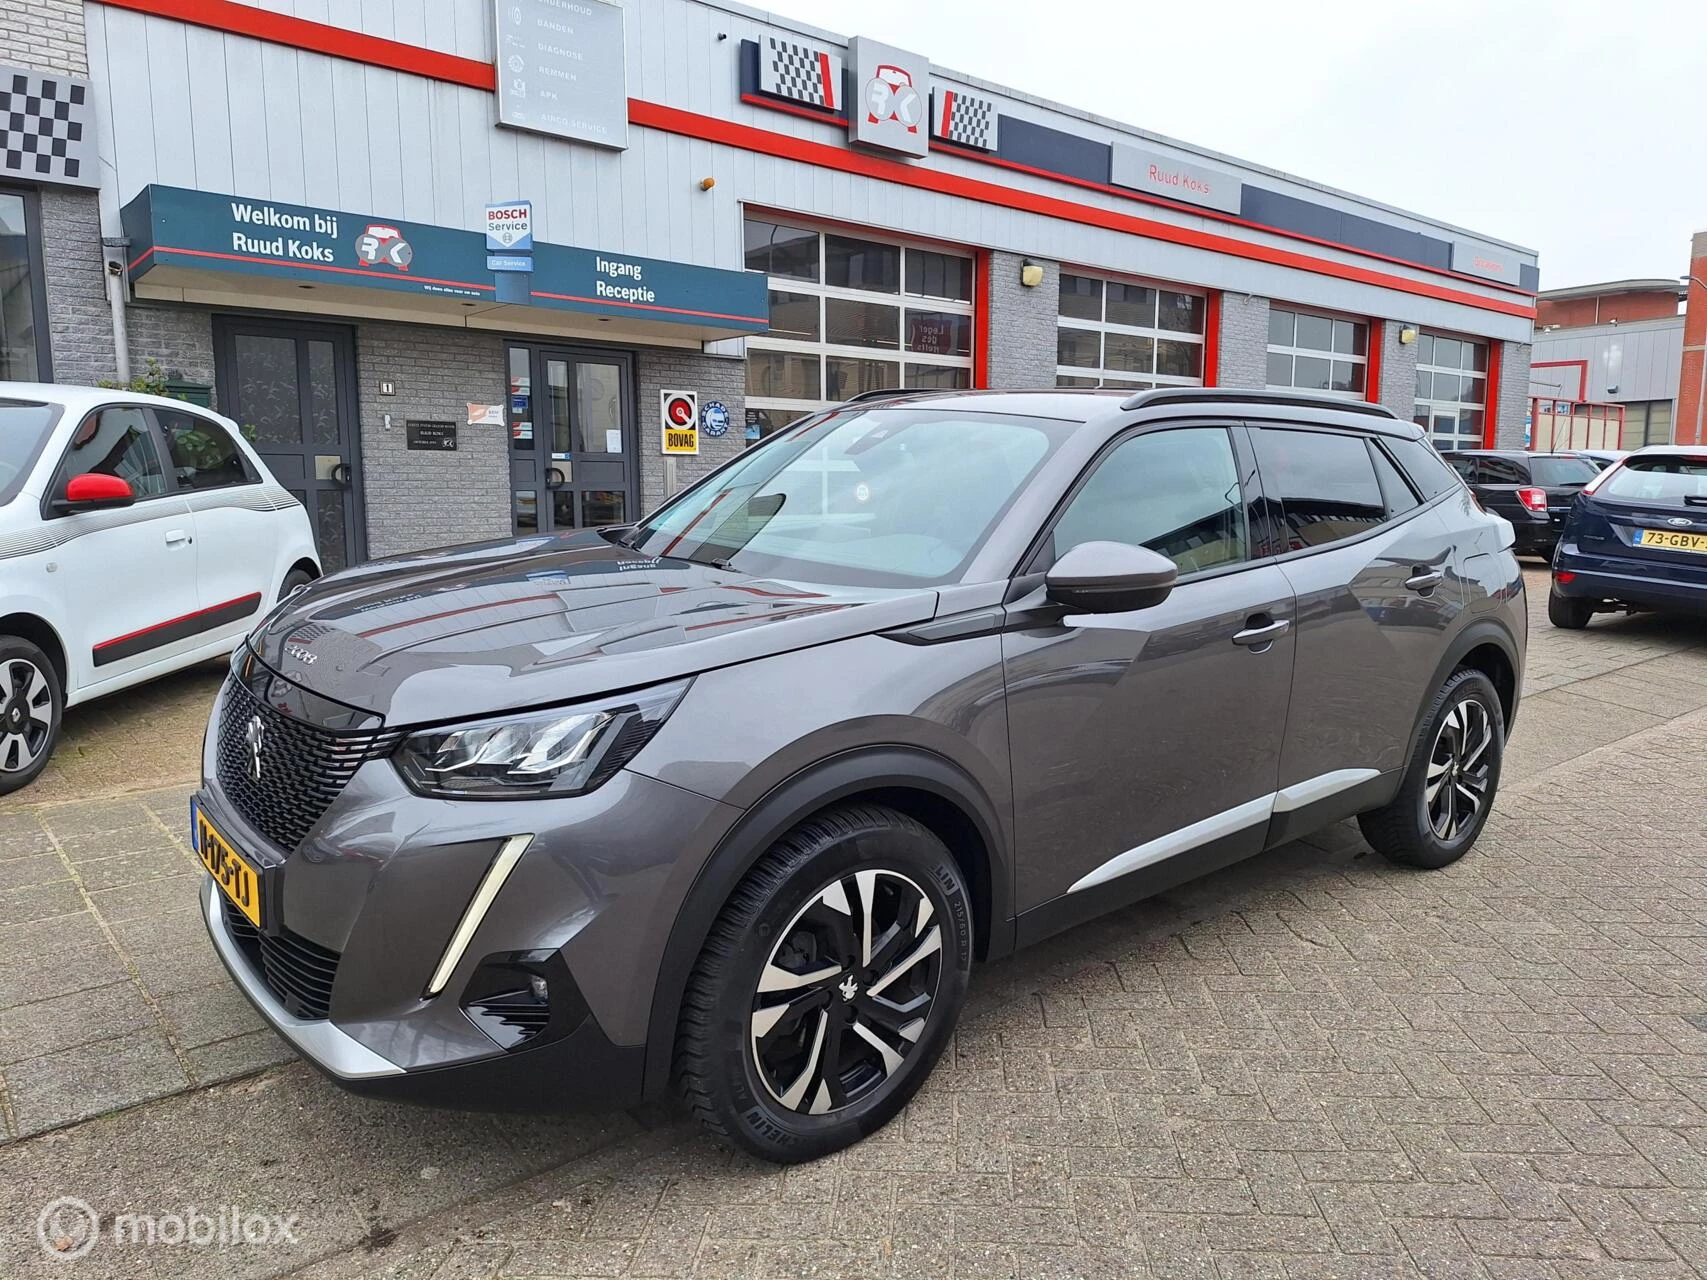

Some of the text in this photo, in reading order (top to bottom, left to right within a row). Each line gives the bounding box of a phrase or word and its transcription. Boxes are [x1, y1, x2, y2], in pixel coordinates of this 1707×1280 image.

[539, 0, 592, 16] NDERHOUD
[537, 19, 574, 35] BANDEN
[537, 43, 583, 60] DIAGNOSE
[538, 66, 577, 81] REMMEN
[540, 90, 558, 100] APK
[541, 113, 608, 134] AIRCO SERVICE
[1149, 164, 1209, 194] Ruud Koks
[231, 202, 338, 239] Welkom bij
[488, 208, 528, 221] BOSCH
[488, 220, 528, 231] Service
[232, 232, 334, 263] Ruud Koks
[596, 256, 642, 281] Ingang
[596, 280, 656, 303] Receptie
[667, 432, 694, 448] BOVAG
